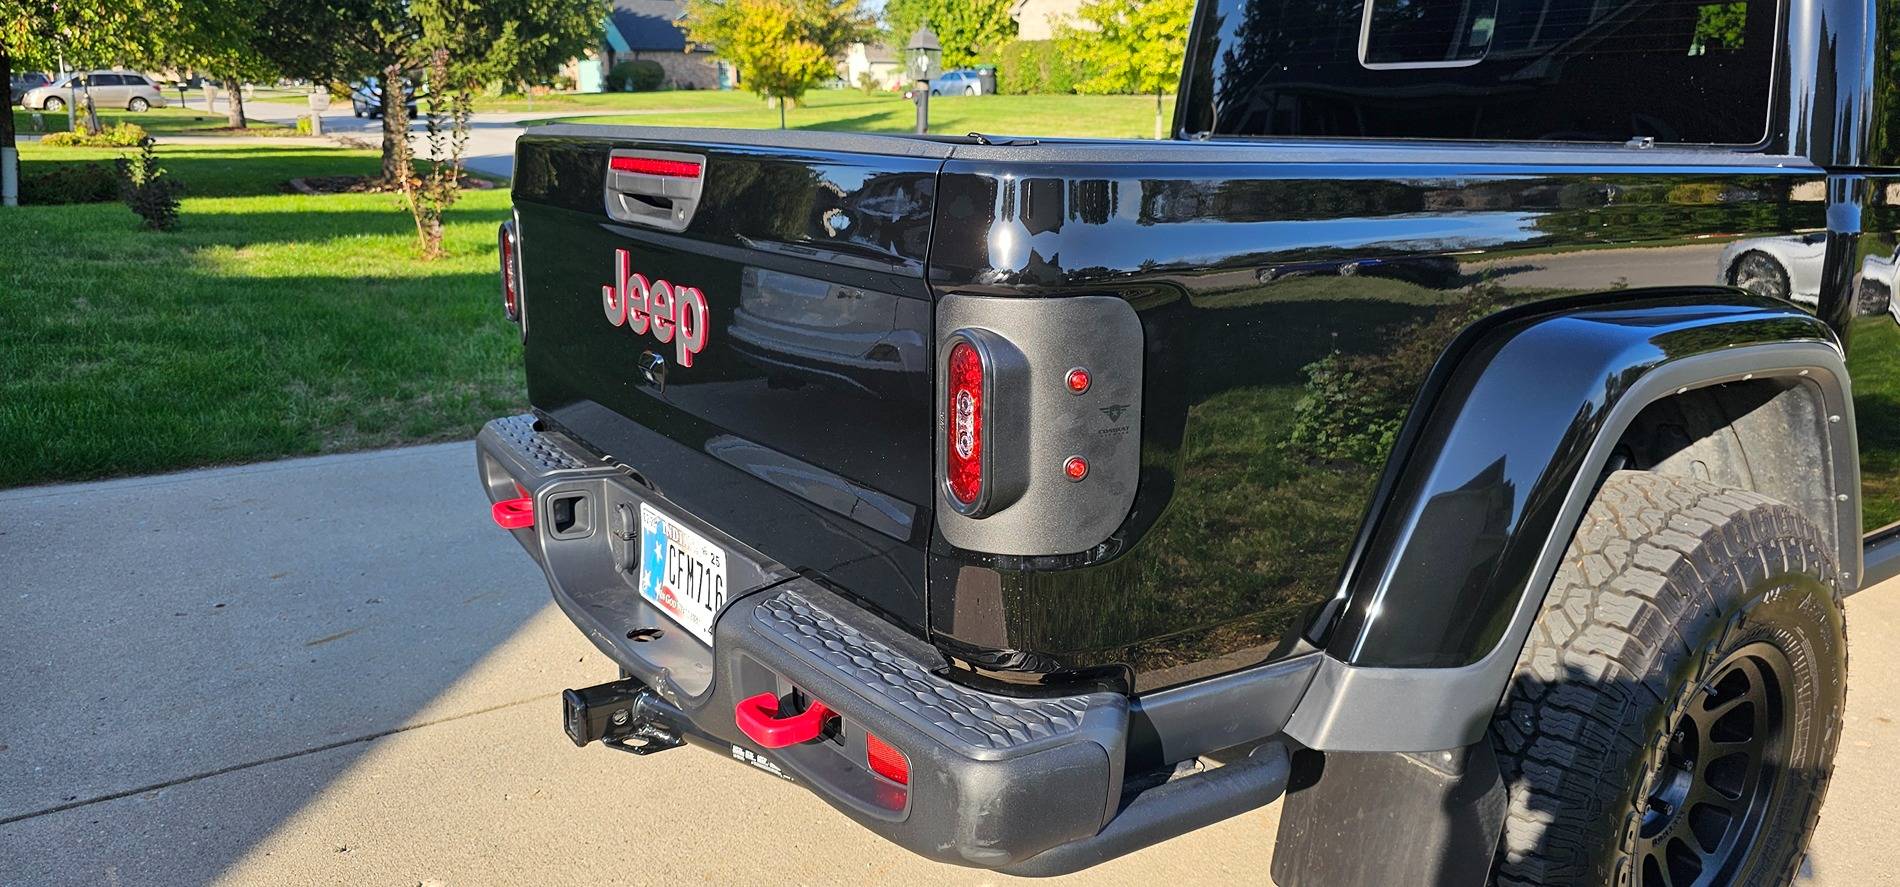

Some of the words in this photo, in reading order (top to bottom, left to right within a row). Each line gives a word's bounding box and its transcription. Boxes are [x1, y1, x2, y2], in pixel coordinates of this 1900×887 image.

[602, 248, 709, 368] Jeep
[669, 544, 723, 612] CFM716
[710, 552, 720, 568] 25
